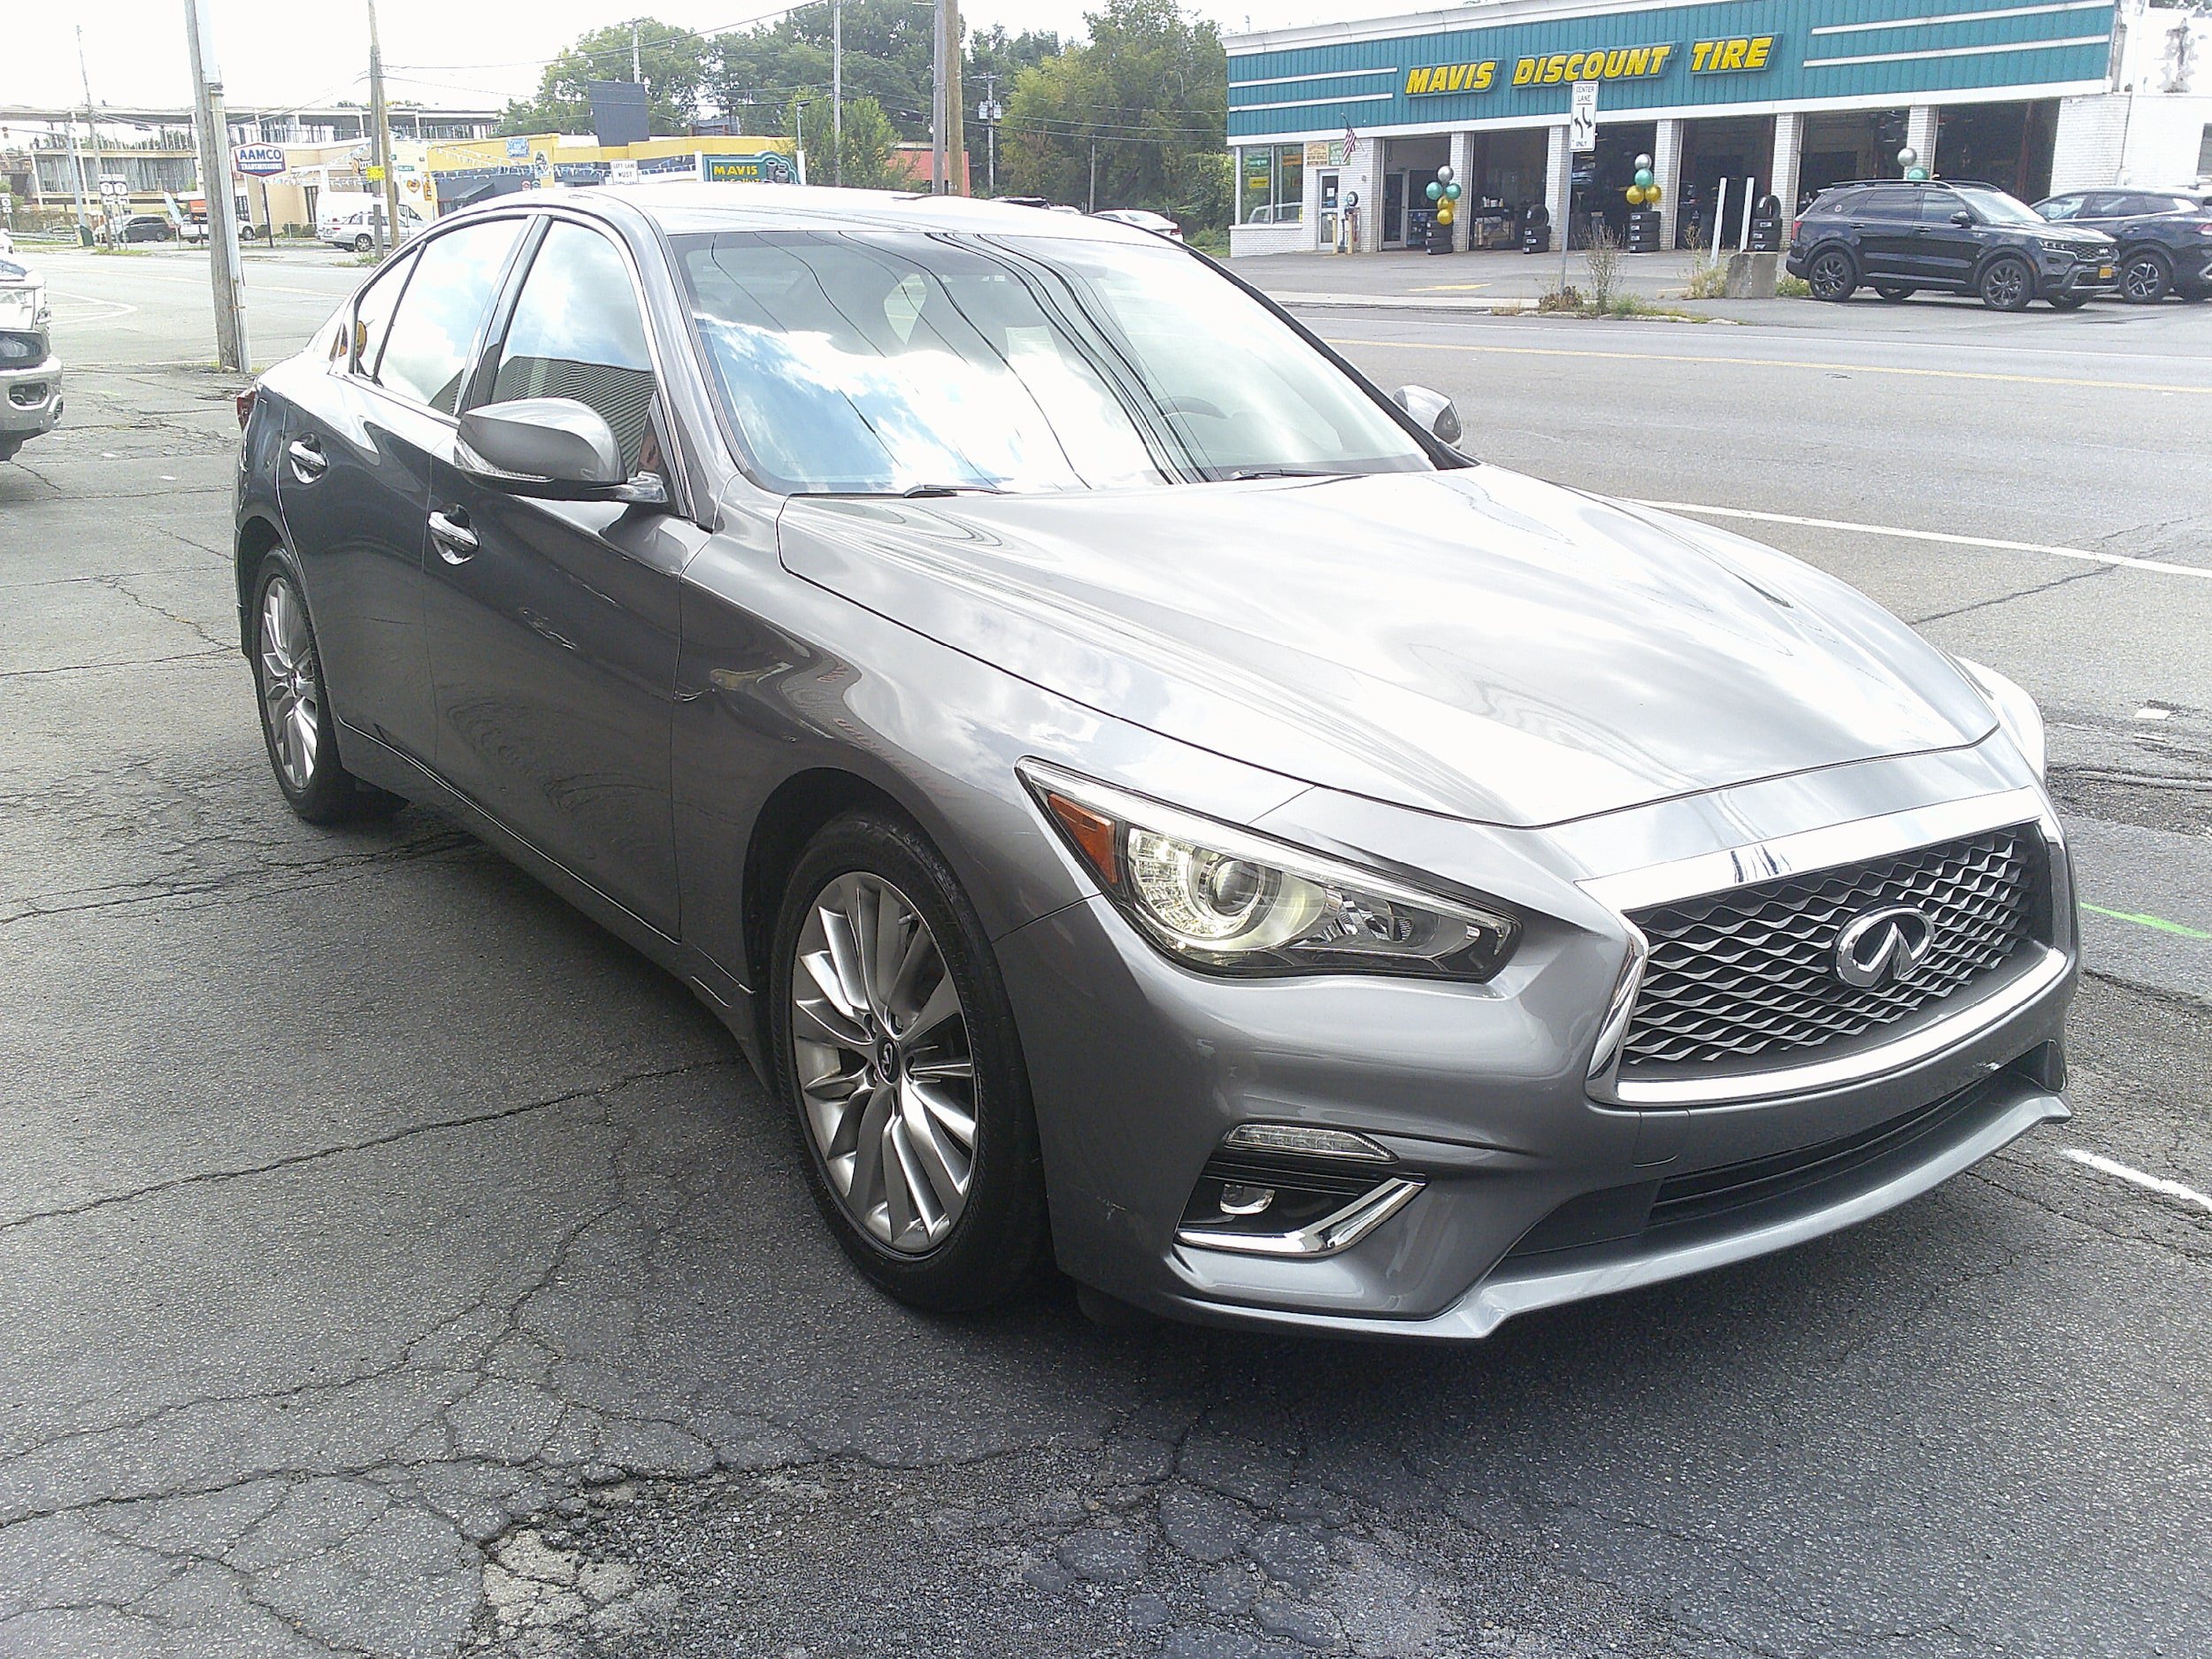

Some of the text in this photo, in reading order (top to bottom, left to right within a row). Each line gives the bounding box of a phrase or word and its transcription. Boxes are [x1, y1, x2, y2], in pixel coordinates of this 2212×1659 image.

[1405, 38, 1772, 93] MAVIS DISCOUNT TIRE
[240, 150, 282, 160] AAMCO
[713, 165, 758, 176] MAVIS
